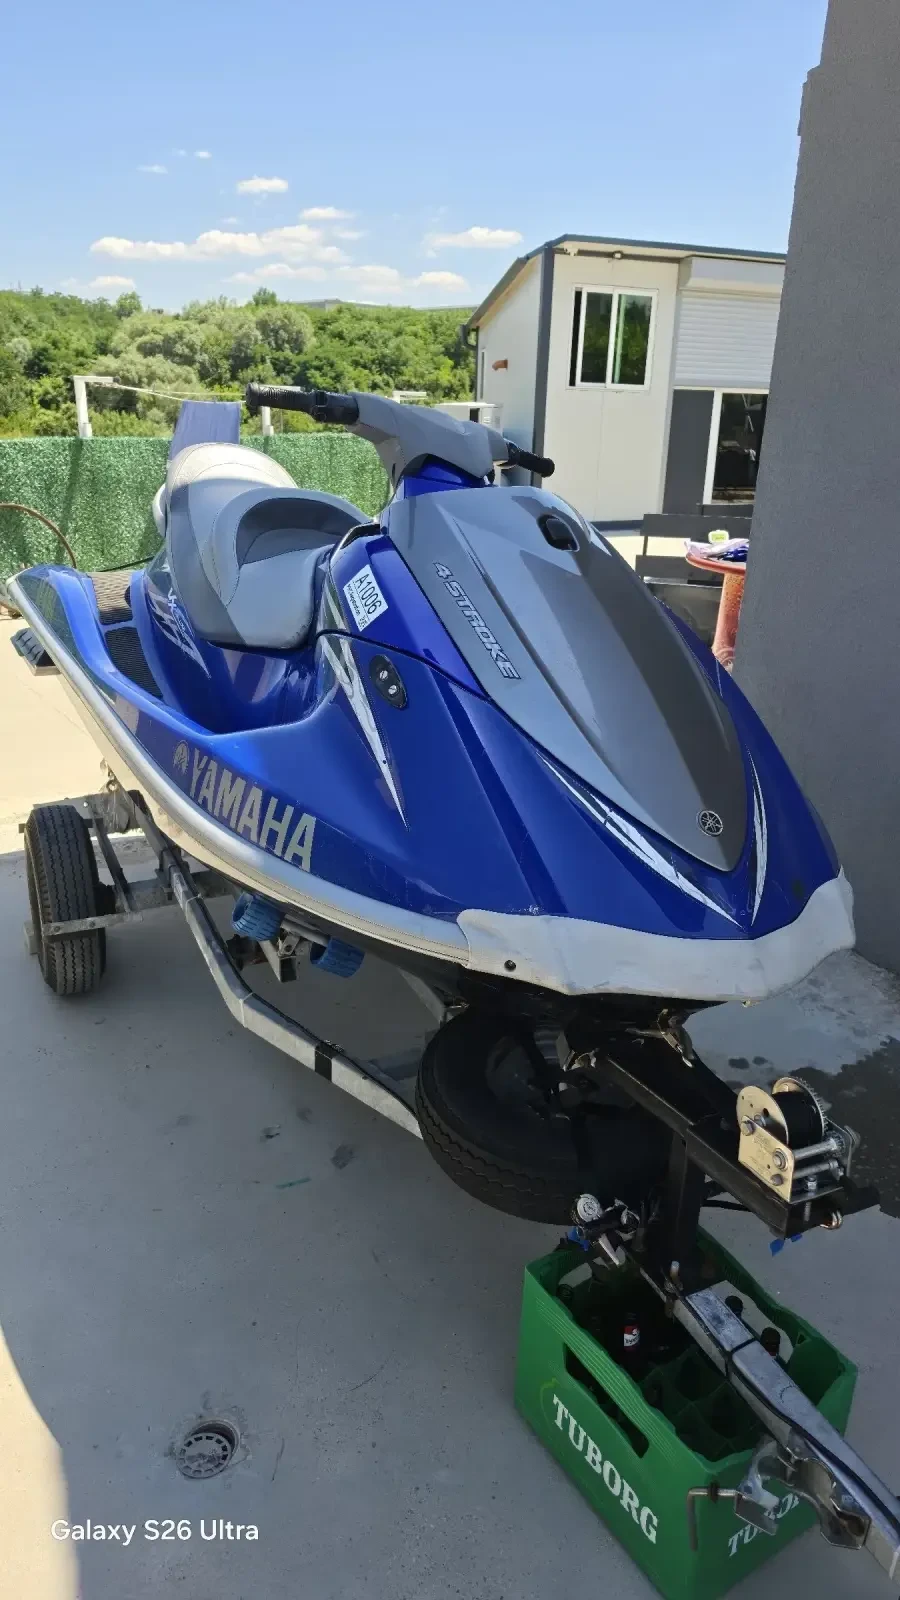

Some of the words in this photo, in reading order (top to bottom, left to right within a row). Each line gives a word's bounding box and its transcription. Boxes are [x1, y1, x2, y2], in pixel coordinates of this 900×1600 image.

[355, 573, 381, 615] A1006
[433, 562, 454, 580] 4
[443, 580, 521, 680] STROKE
[190, 748, 316, 873] YAMAHA
[552, 1394, 659, 1544] TUBORG
